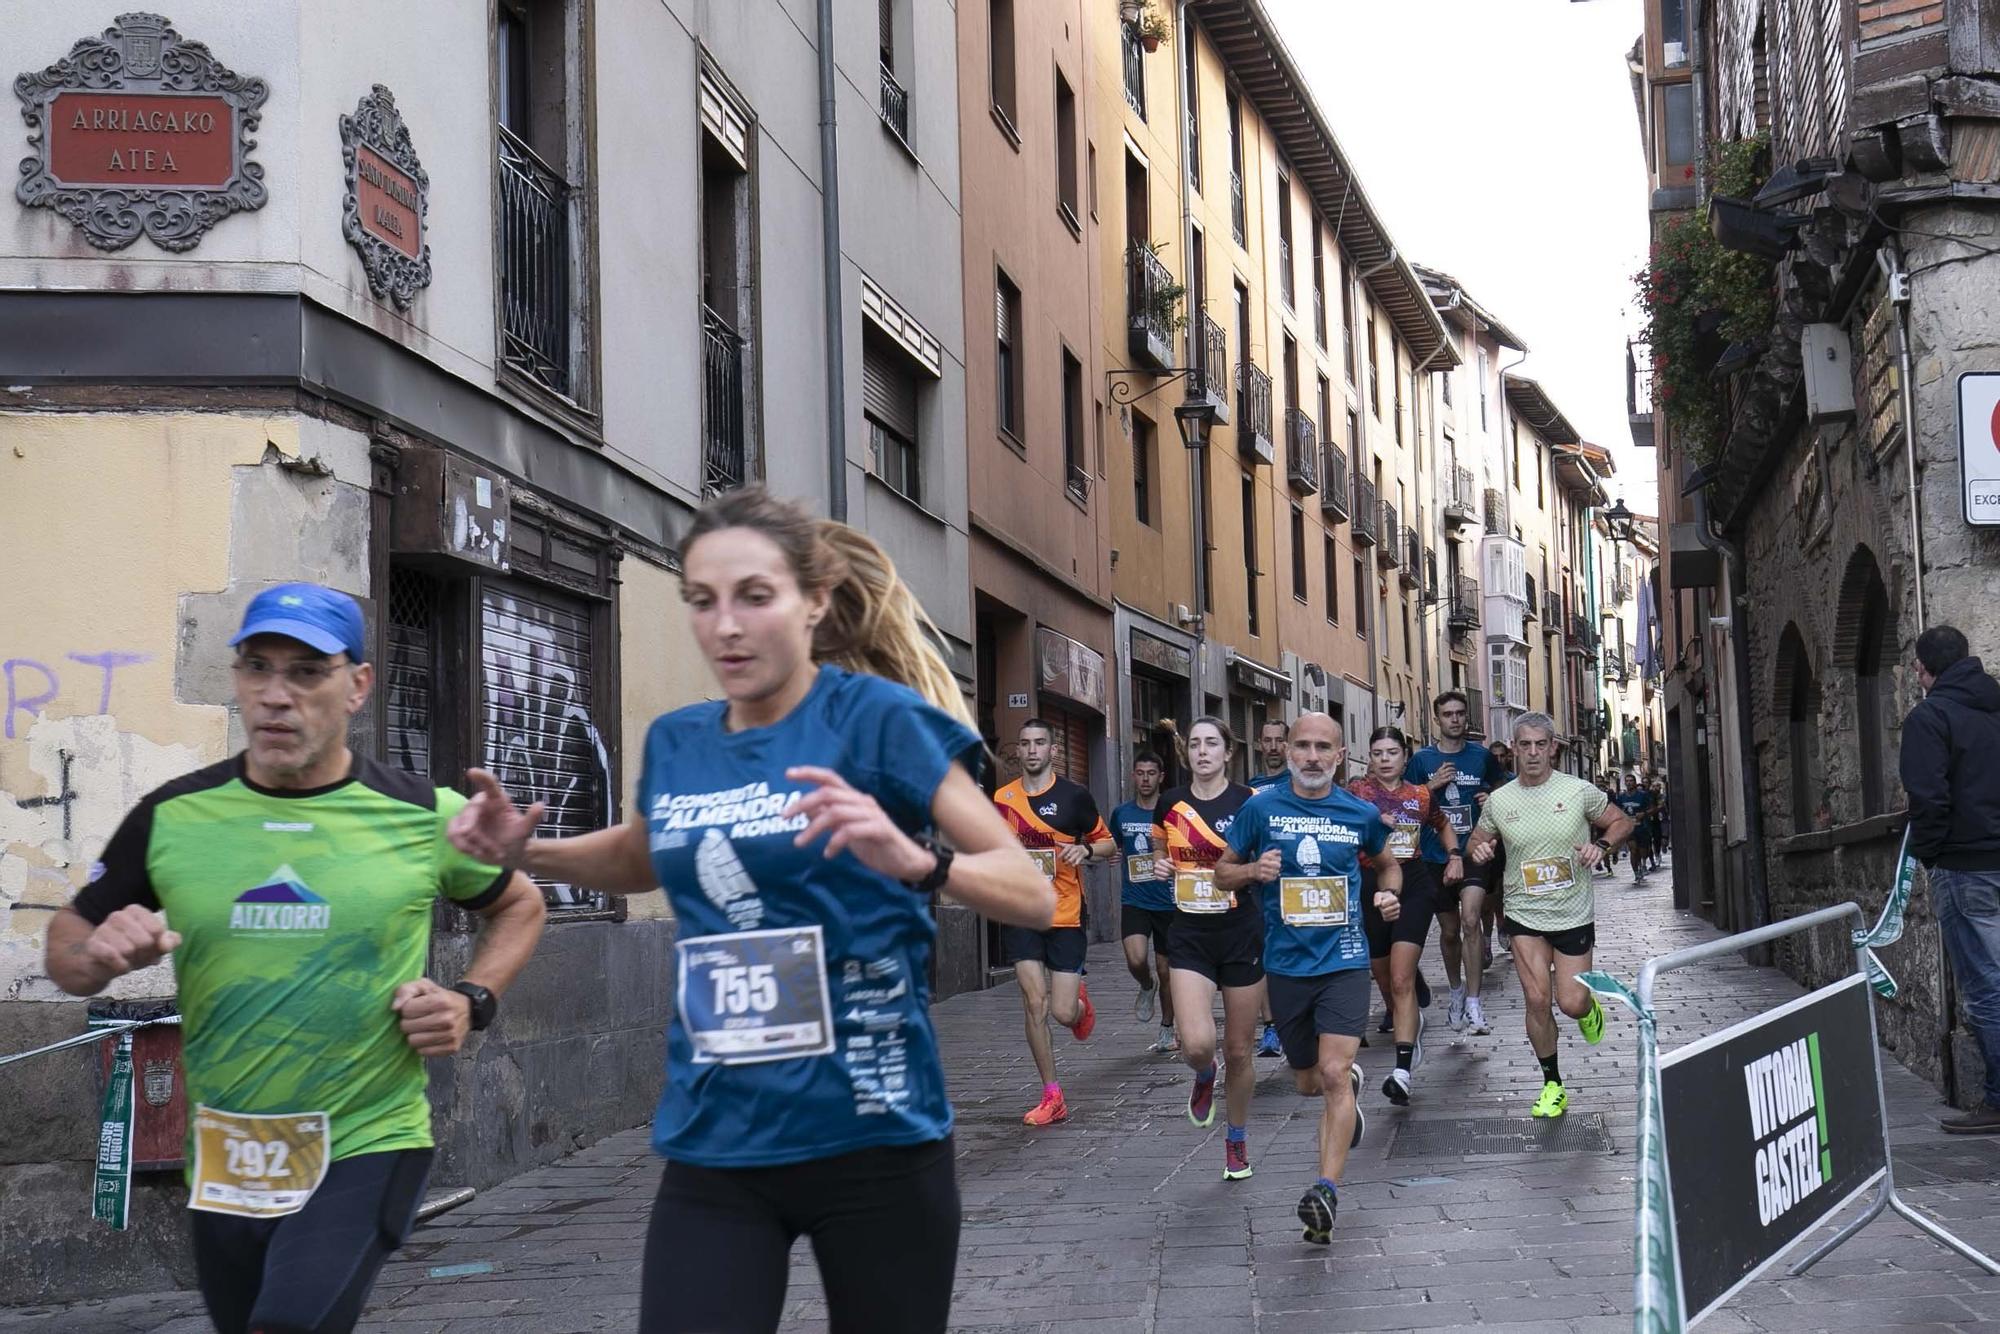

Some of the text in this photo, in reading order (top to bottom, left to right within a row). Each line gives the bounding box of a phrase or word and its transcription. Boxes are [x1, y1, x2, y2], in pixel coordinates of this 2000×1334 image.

[71, 108, 214, 134] ARRIAGAKO
[107, 148, 179, 173] ATEA
[1010, 695, 1027, 705] 46
[671, 782, 769, 809] CONQUISTA
[1280, 816, 1332, 825] CONQUISTA
[1282, 823, 1348, 835] ALMENDRA
[1317, 834, 1359, 845] KONKISTA
[1536, 865, 1559, 880] 212
[1299, 889, 1330, 908] 193
[708, 964, 779, 1015] 755
[1744, 1037, 1815, 1141] VITORIA
[99, 1121, 114, 1162] GASTEIZ
[109, 1121, 125, 1163] VITORIA
[224, 1138, 291, 1178] 292
[1755, 1115, 1823, 1227] GASTEIZ
